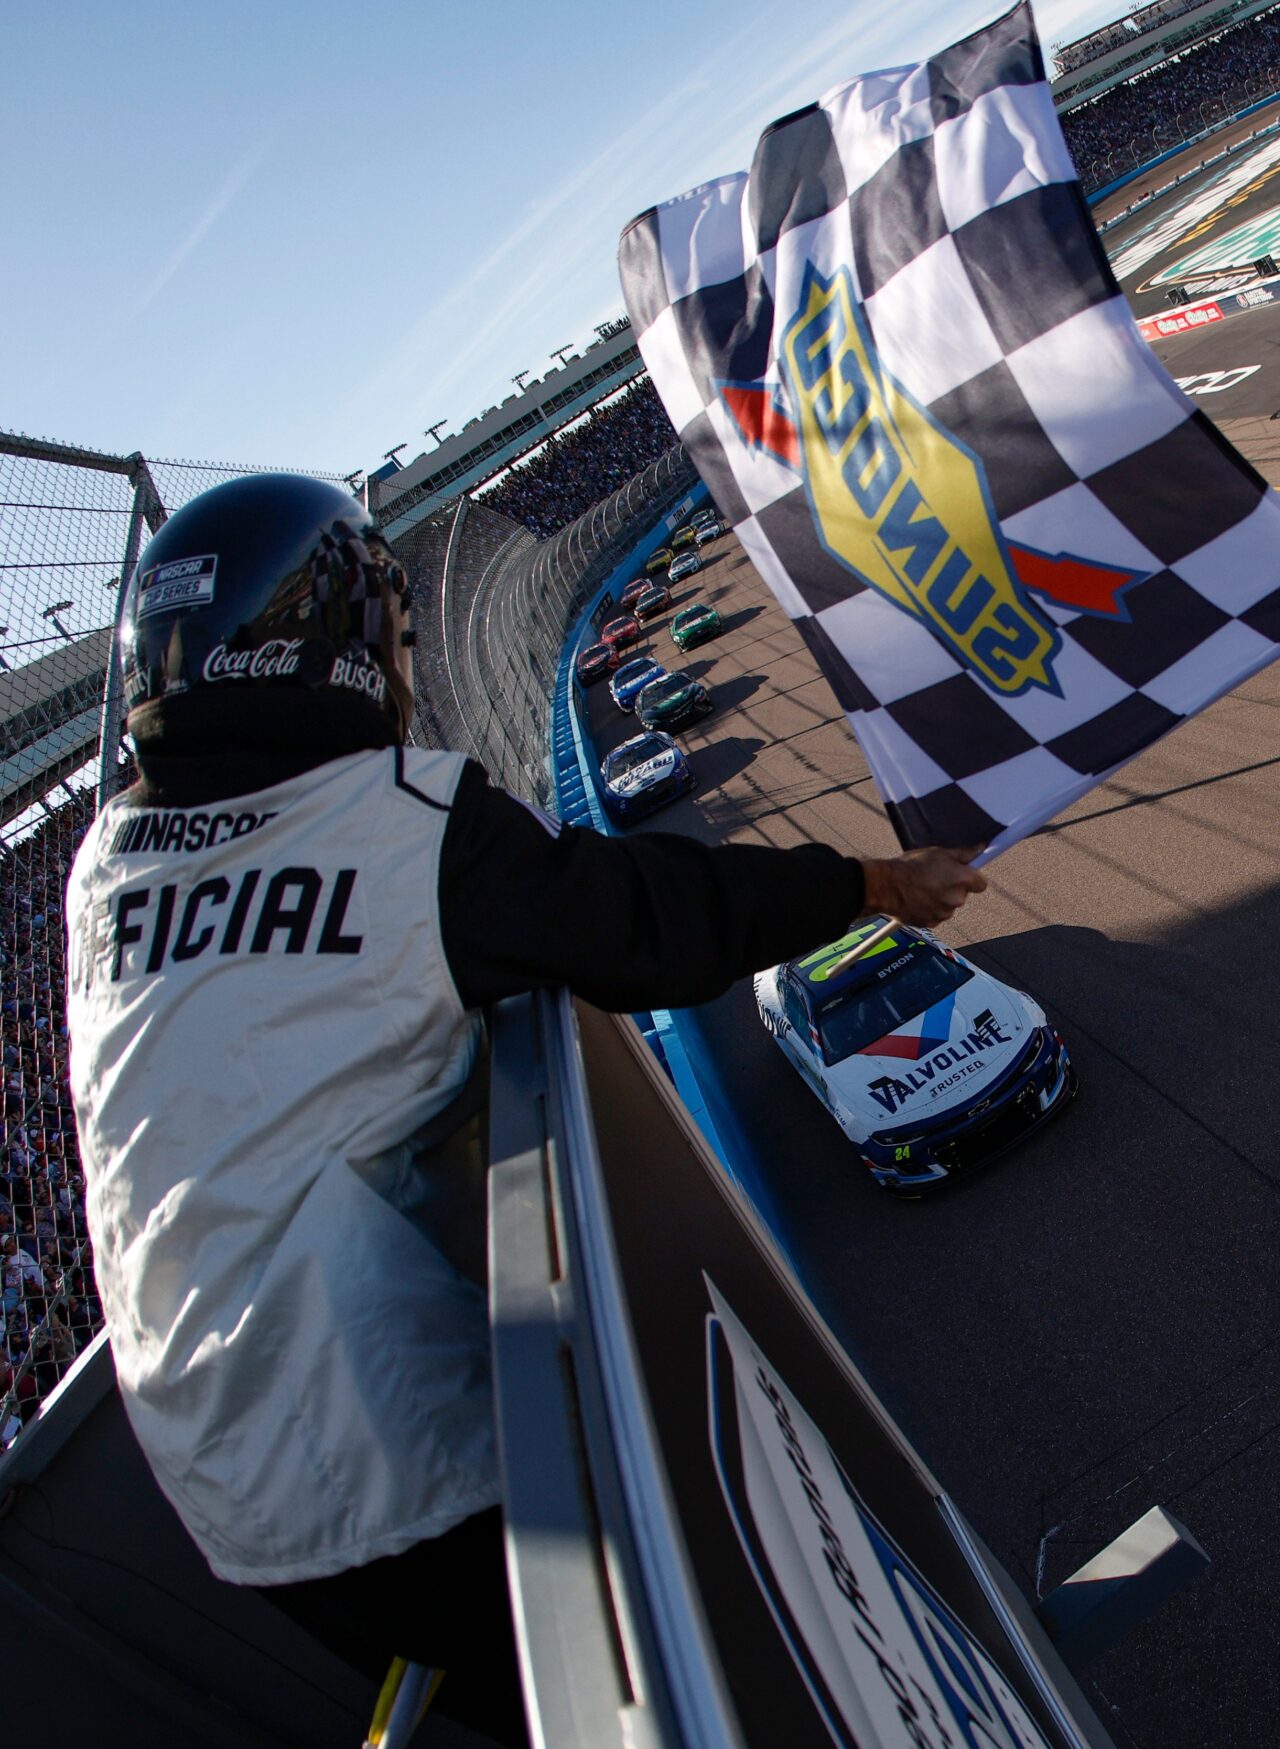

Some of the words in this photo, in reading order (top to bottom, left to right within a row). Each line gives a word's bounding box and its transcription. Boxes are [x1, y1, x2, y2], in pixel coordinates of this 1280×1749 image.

[158, 559, 204, 582] NASCAR
[162, 581, 201, 599] SERIES
[203, 638, 304, 683] Coca-Cola
[327, 656, 387, 704] BUSCH
[877, 952, 915, 979] BYRON
[867, 1008, 1013, 1115] VALVOLINE
[929, 1060, 985, 1097] TRUSTED
[895, 1145, 911, 1162] 24
